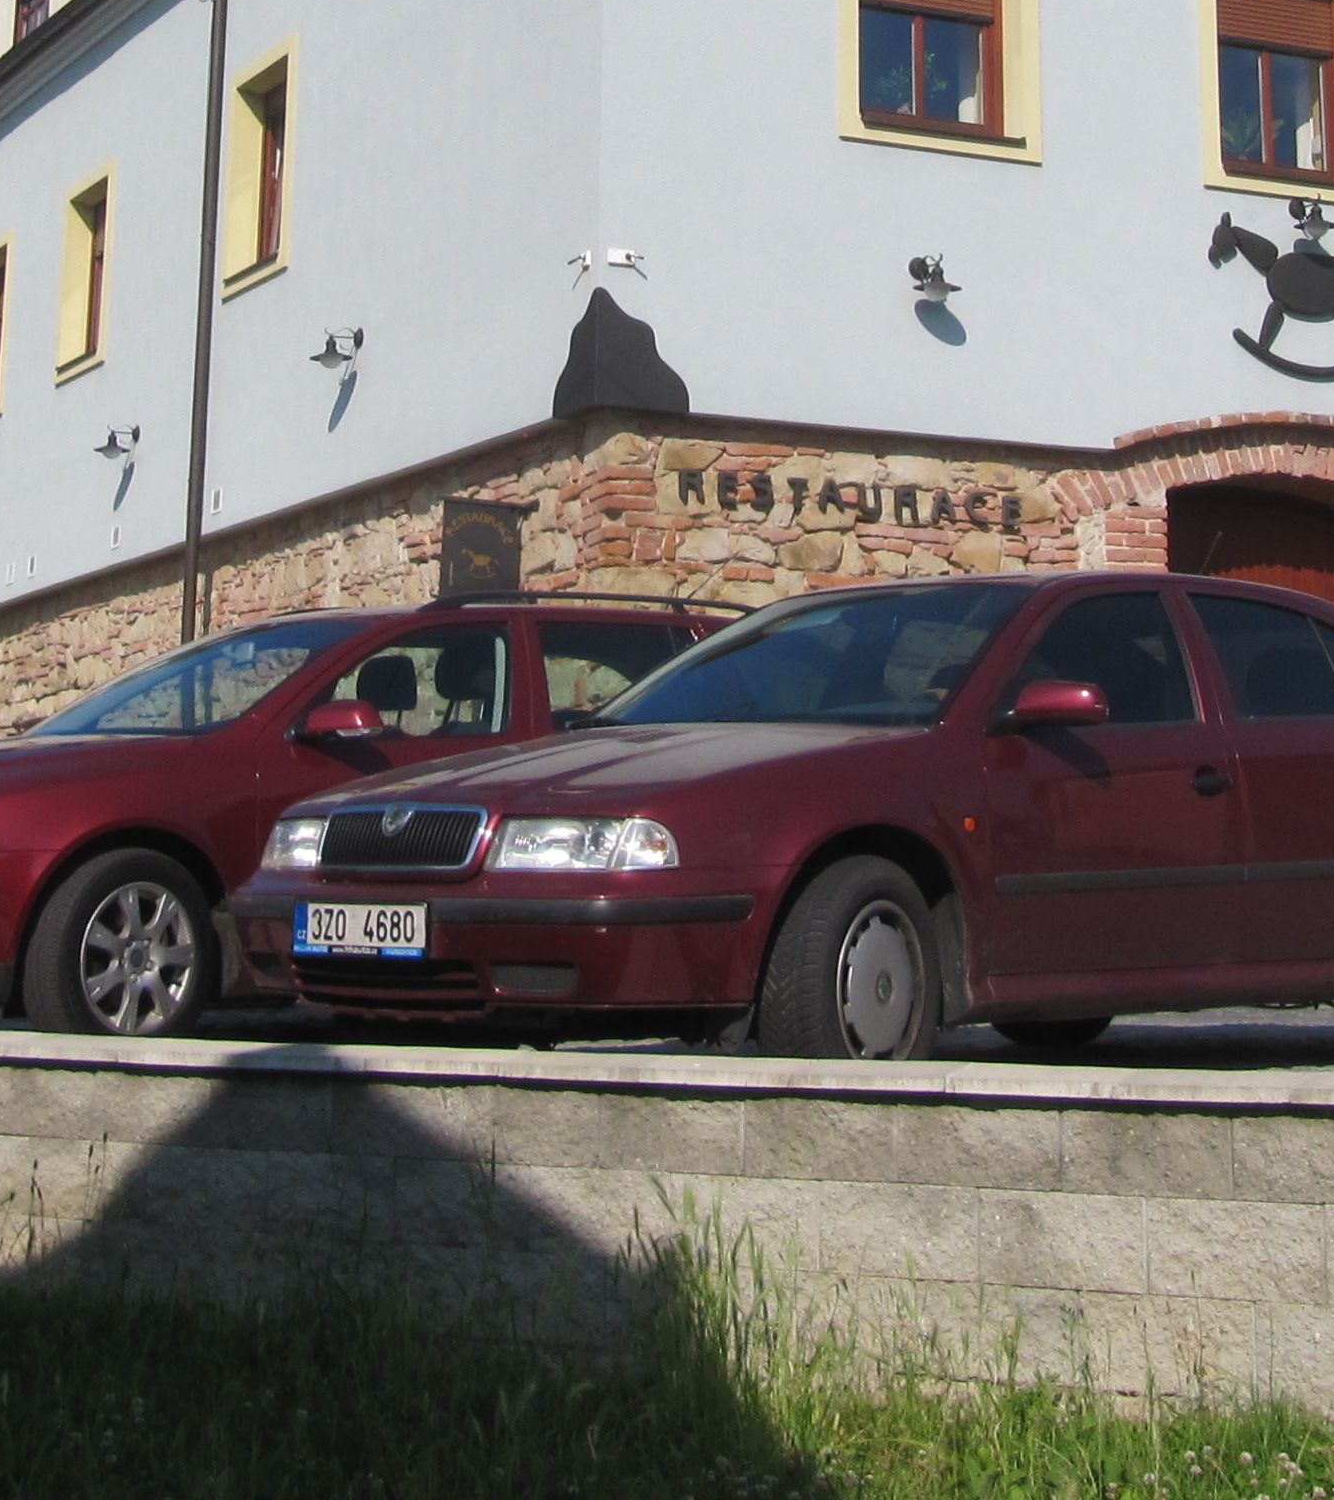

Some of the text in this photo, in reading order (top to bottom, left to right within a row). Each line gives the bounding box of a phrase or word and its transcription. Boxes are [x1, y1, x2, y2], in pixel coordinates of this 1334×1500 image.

[677, 468, 1023, 536] RESTAURACE
[444, 512, 515, 545] RESTAURACE
[363, 909, 415, 943] 4680
